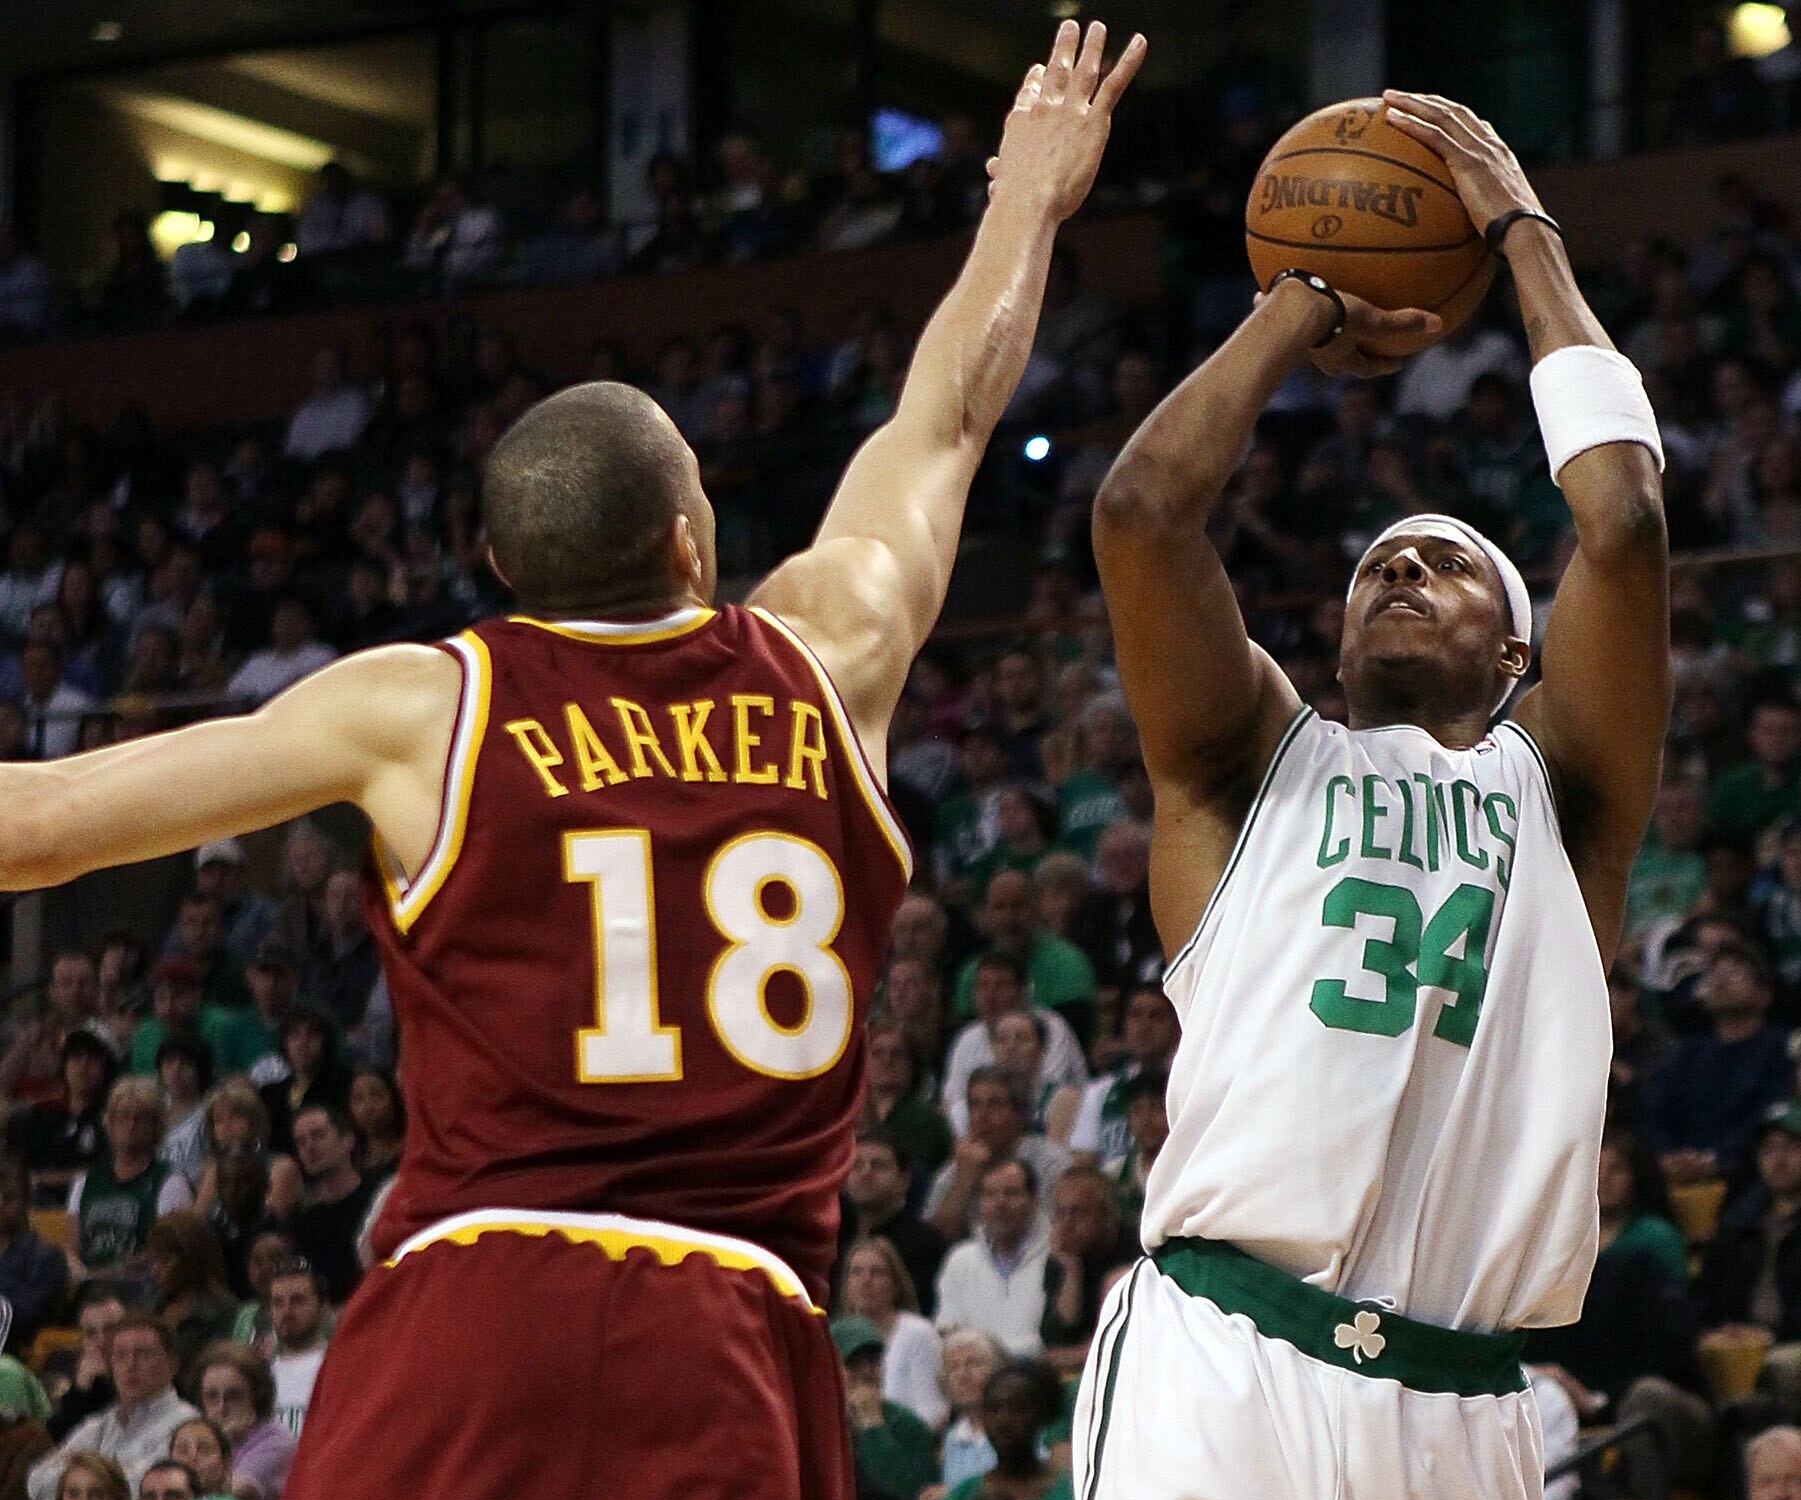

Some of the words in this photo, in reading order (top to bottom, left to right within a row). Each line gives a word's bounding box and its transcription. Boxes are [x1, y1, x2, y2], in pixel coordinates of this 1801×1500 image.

[1261, 174, 1424, 228] SPALDING
[506, 695, 829, 800] PARKER
[561, 829, 854, 1084] 18
[1309, 876, 1496, 1049] 34
